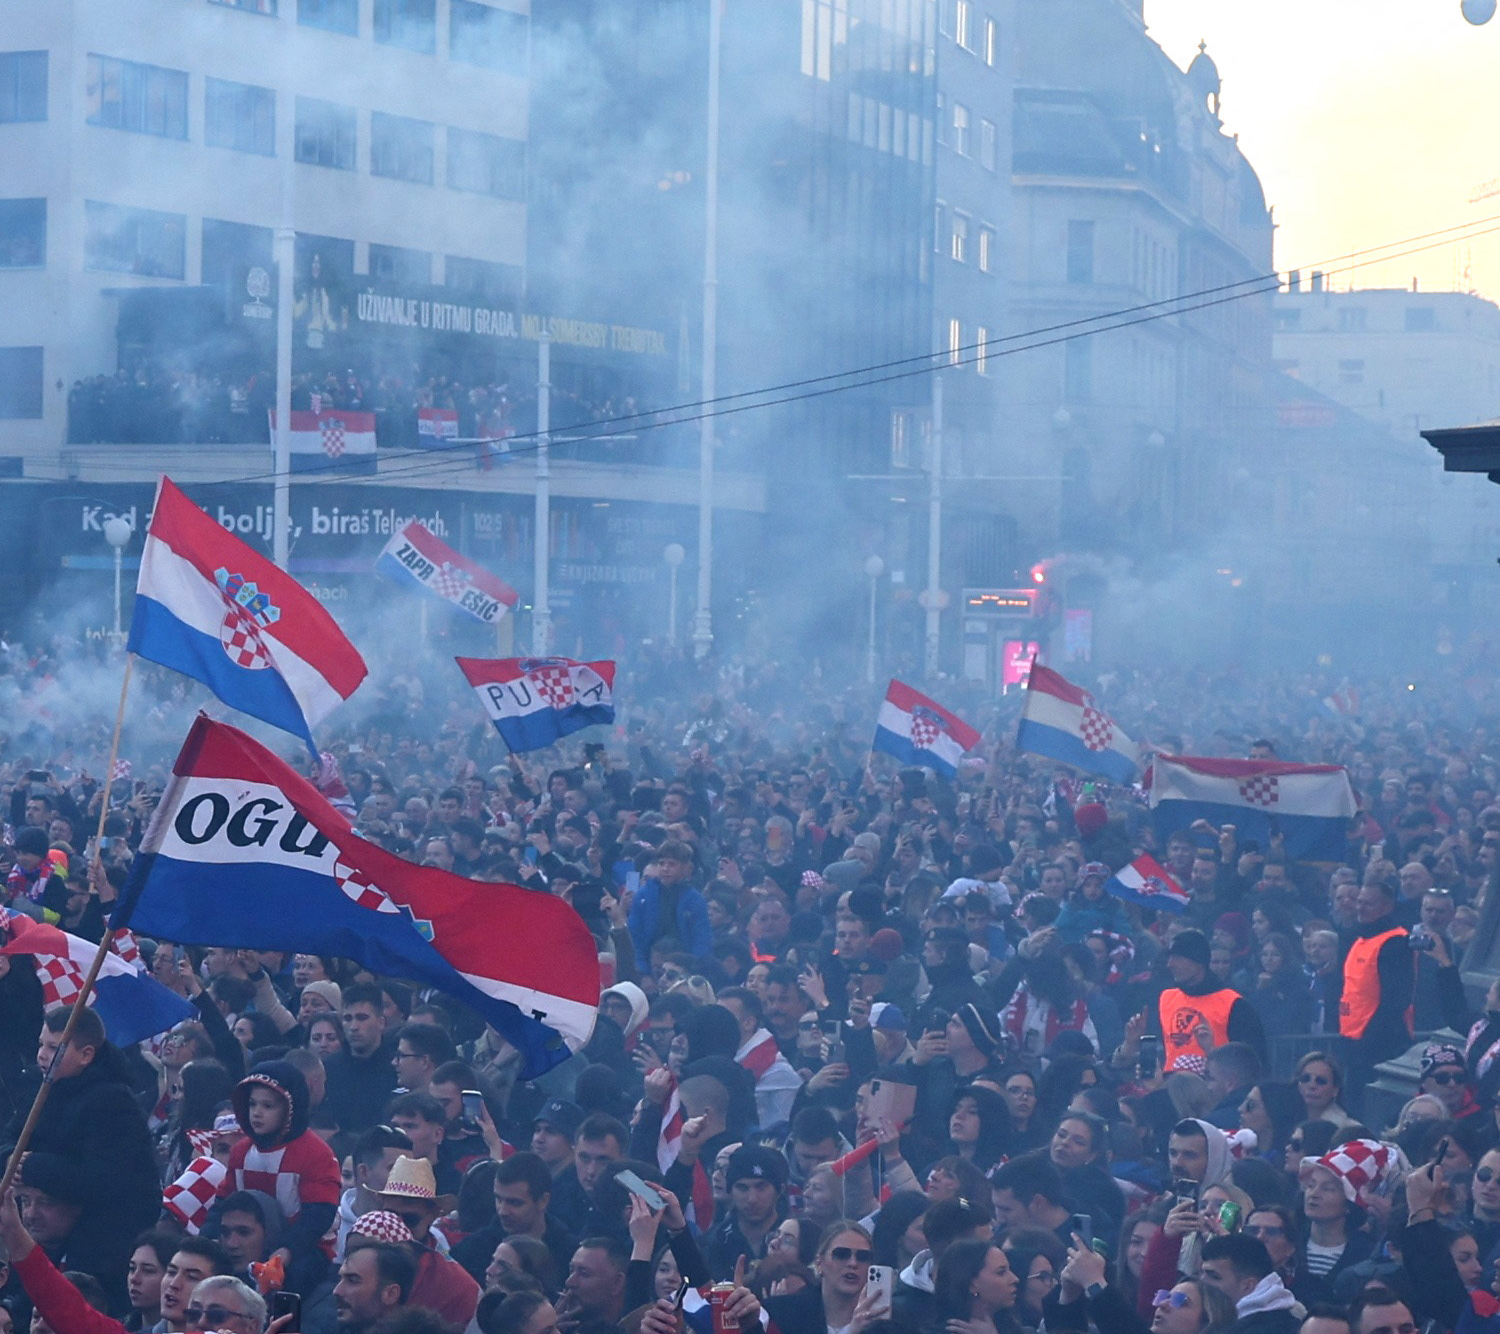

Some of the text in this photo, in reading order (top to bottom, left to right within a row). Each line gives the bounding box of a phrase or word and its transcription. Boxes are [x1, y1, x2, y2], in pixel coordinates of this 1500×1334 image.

[421, 303, 430, 329] U
[432, 303, 472, 335] RITMU
[218, 506, 302, 540] bolj,
[311, 507, 370, 535] biraš
